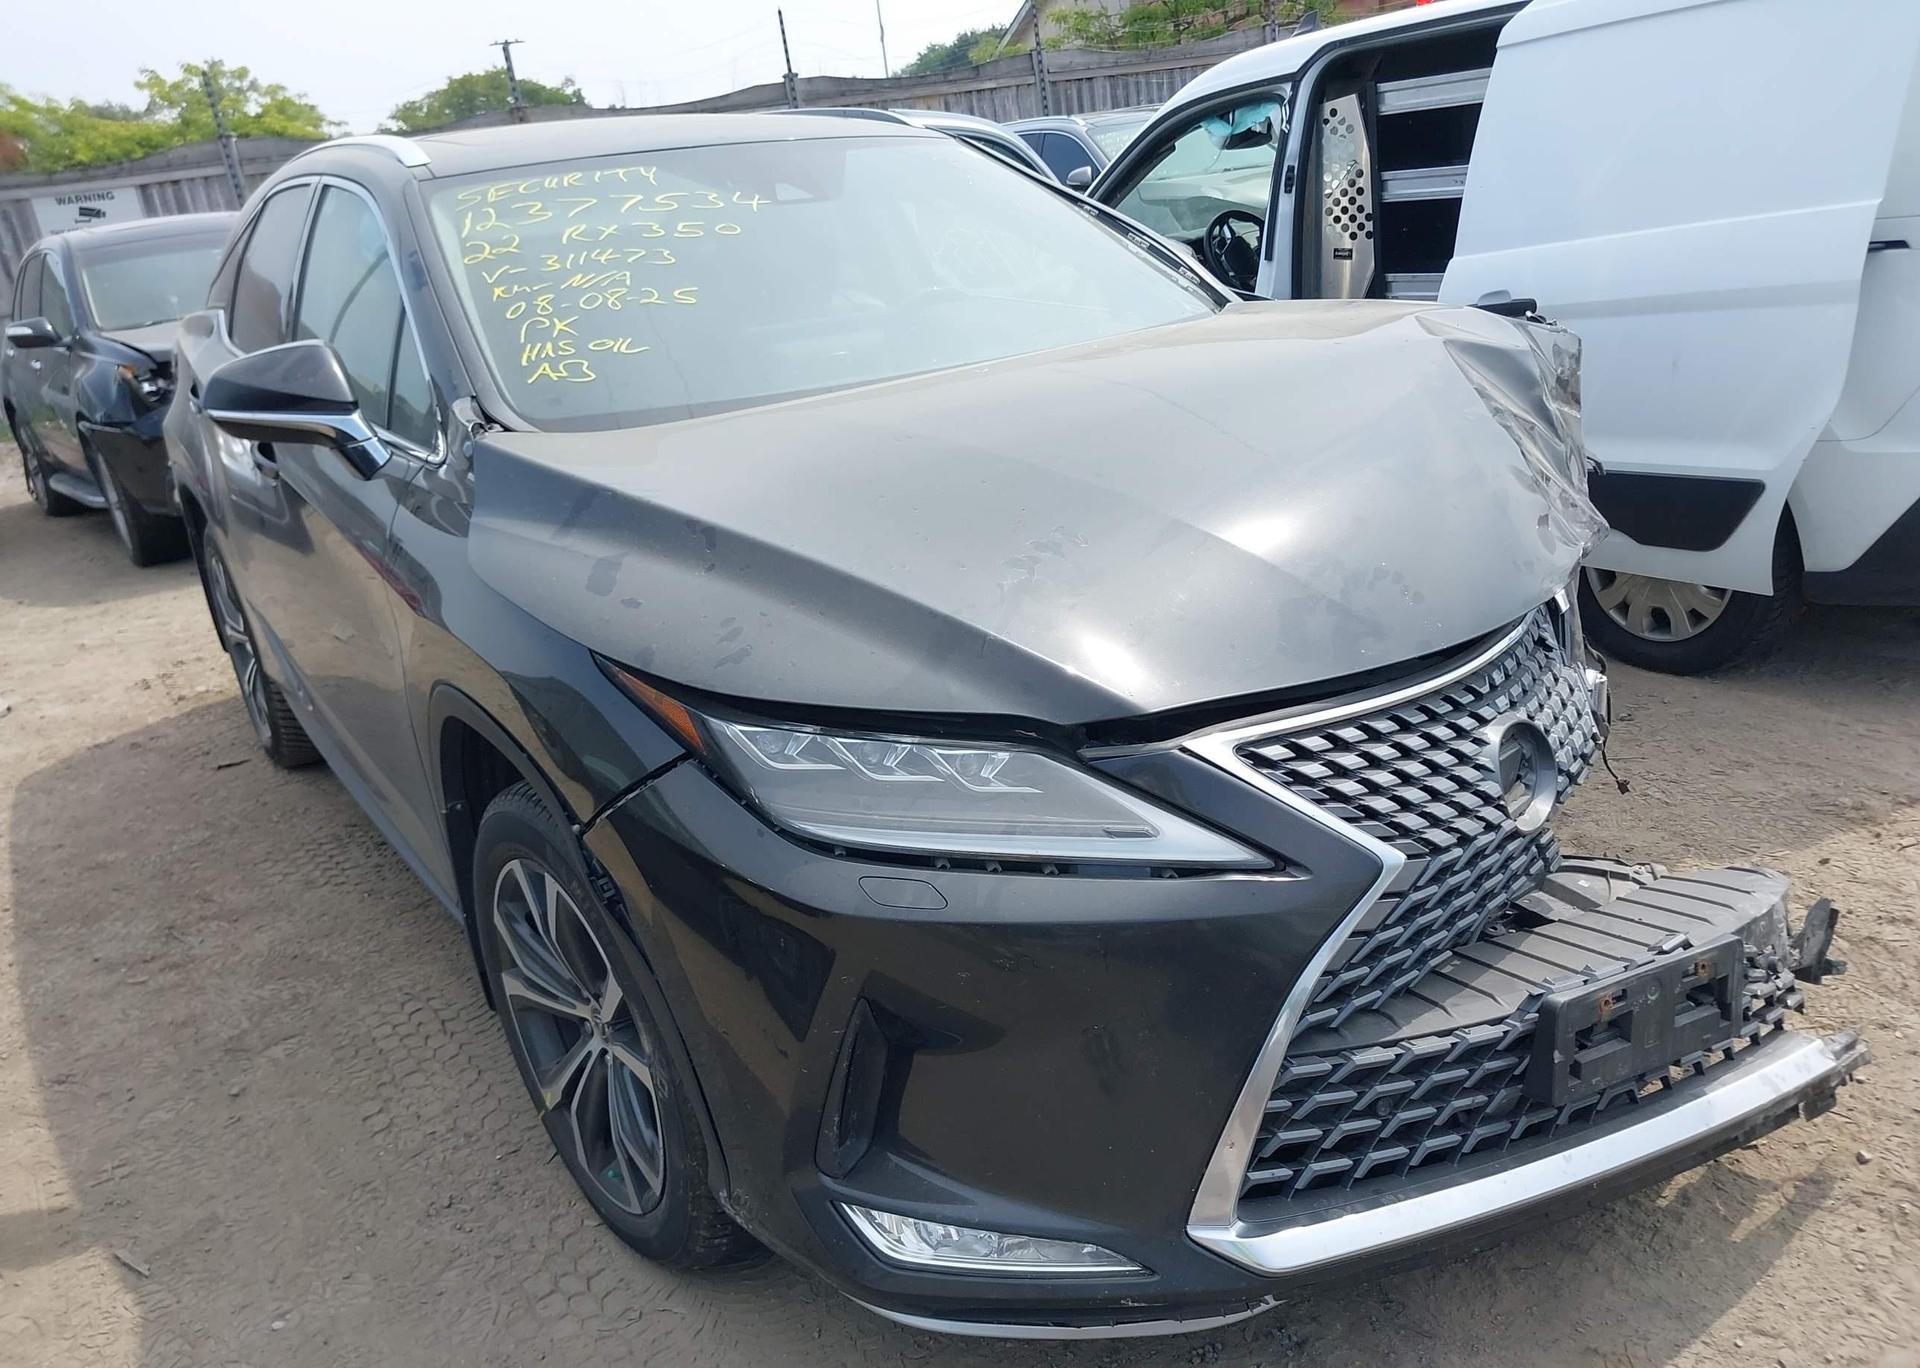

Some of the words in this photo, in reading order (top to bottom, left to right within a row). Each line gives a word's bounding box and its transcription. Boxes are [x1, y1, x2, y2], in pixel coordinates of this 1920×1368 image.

[55, 191, 115, 206] WARNING
[455, 166, 657, 211] SECURITY
[461, 191, 772, 238] 12377534
[463, 234, 523, 265] 22
[562, 224, 623, 244] RX
[632, 222, 742, 239] 350
[540, 248, 677, 272] 311473
[588, 337, 649, 353] OIL
